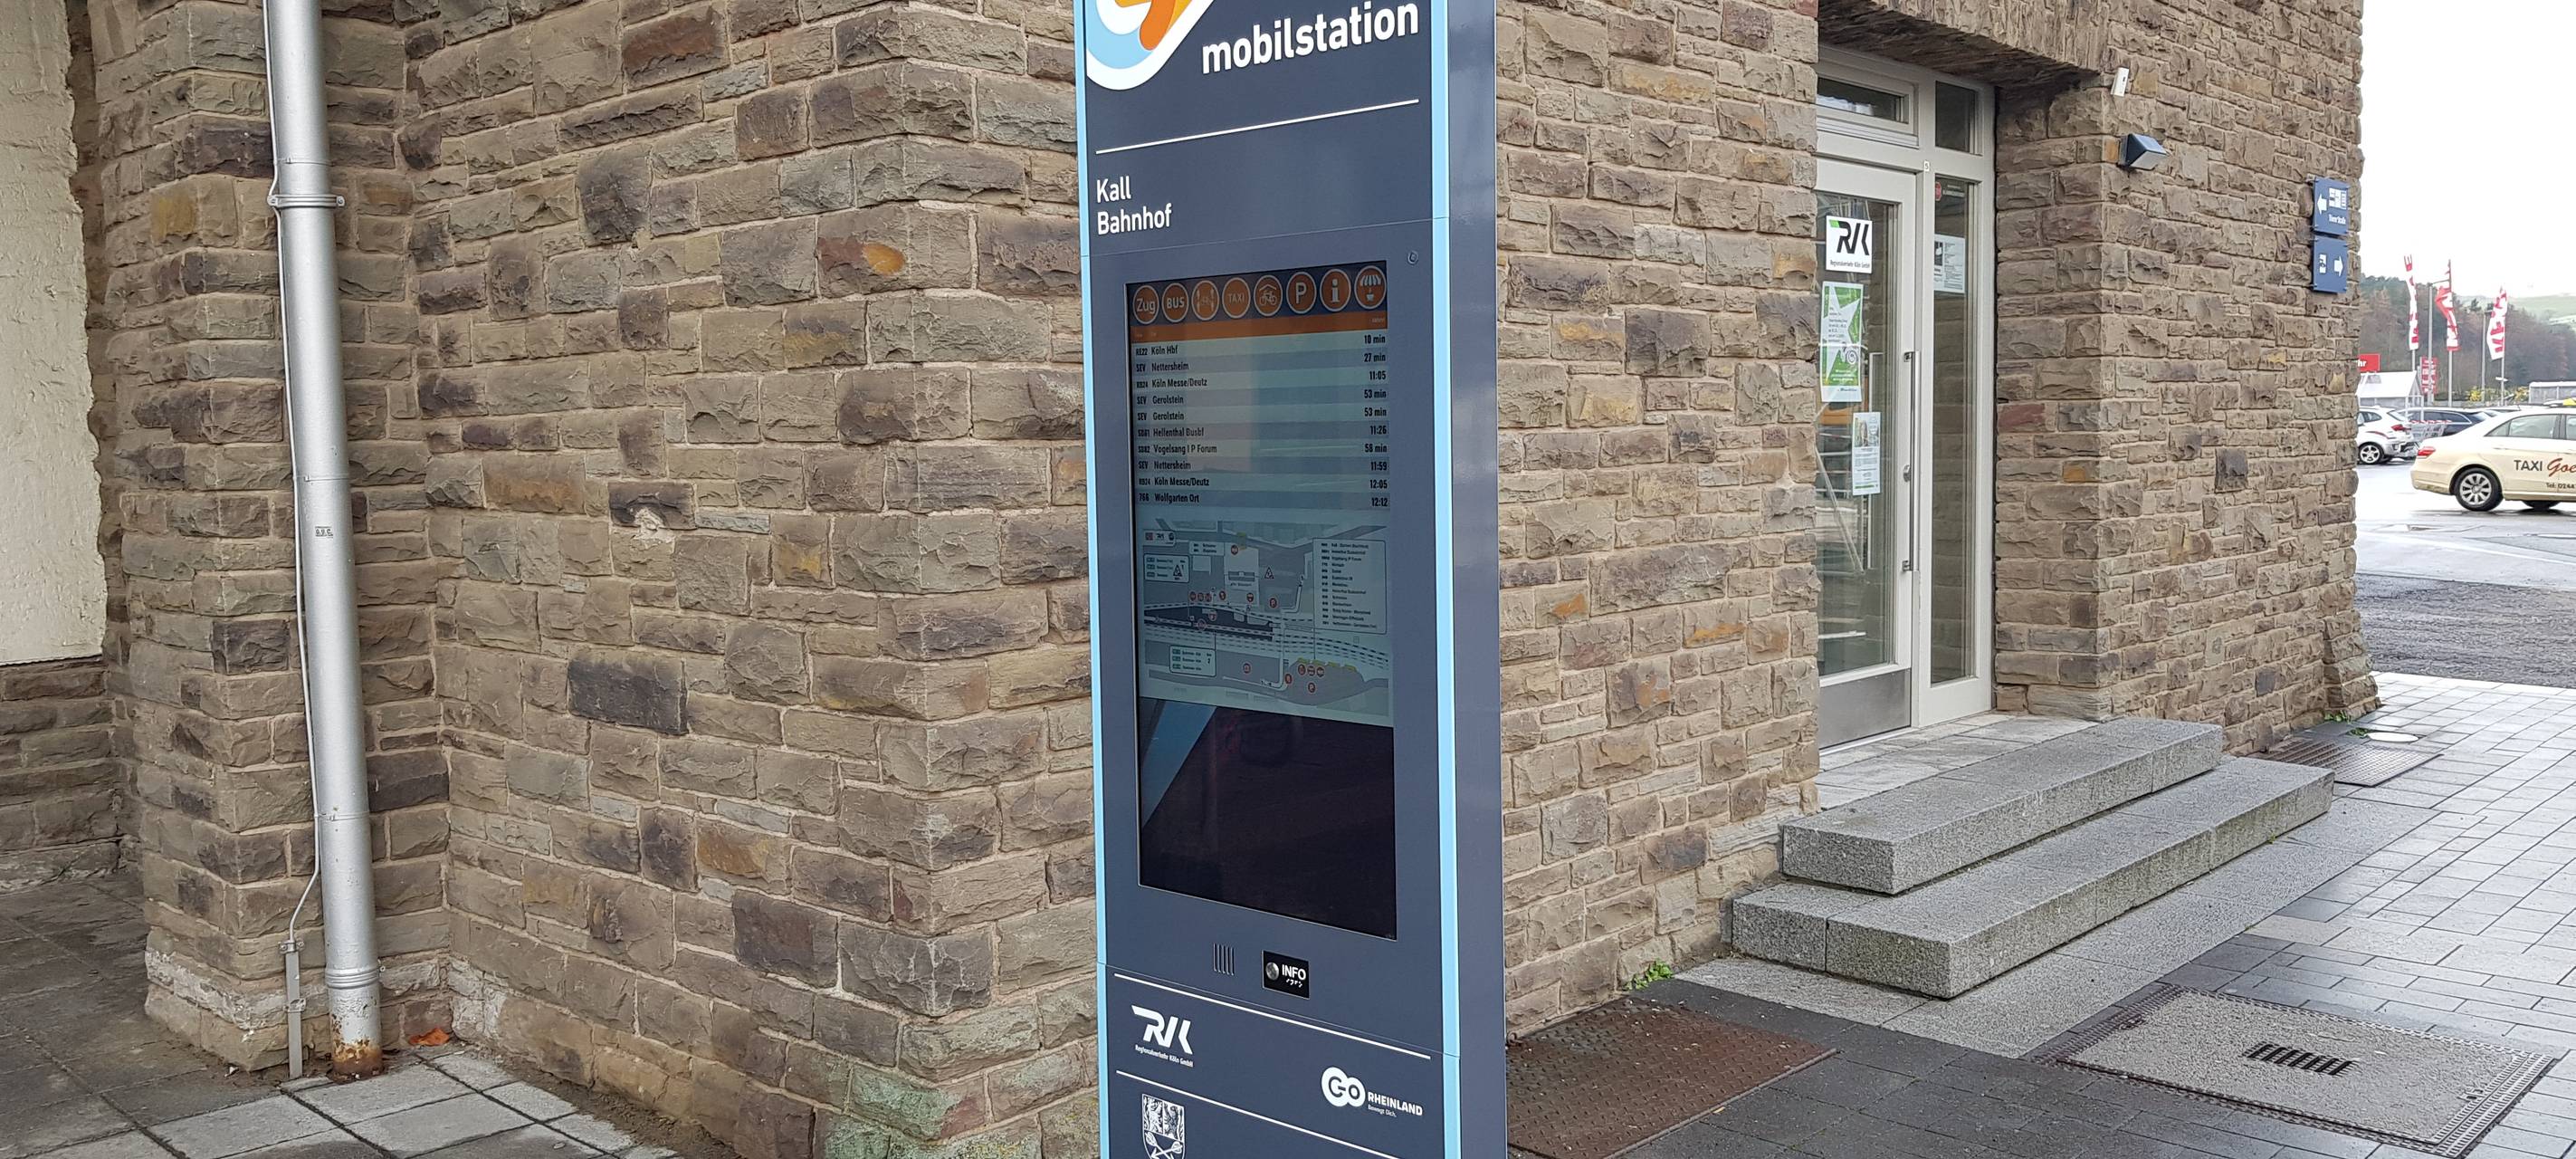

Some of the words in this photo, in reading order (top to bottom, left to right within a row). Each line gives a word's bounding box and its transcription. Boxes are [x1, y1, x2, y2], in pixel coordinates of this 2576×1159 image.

[1202, 1, 1418, 74] mobilstation
[1096, 176, 1131, 204] Kall
[1097, 203, 1172, 235] Bahnhof
[1137, 298, 1156, 314] Zug
[1167, 297, 1185, 309] BUS
[1228, 292, 1245, 302] TAXI
[1296, 282, 1307, 304] P
[1151, 346, 1166, 356] Köln
[1167, 345, 1178, 355] Hbf
[1364, 334, 1371, 344] 10
[1373, 334, 1386, 343] min
[1151, 362, 1188, 372] Nettersheim
[1364, 353, 1372, 362] 27
[1373, 352, 1386, 362] min
[2357, 359, 2367, 368] hr
[1151, 378, 1166, 388] Köln
[1168, 378, 1207, 388] Messe/Deutz
[1369, 370, 1387, 380] 11:05
[1137, 397, 1147, 405] SEV
[1152, 395, 1184, 405] Gerolstein
[1364, 388, 1372, 398] 53
[1374, 388, 1387, 398] min
[1138, 412, 1147, 420] SEV
[1153, 411, 1184, 420] Gerolstein
[1364, 407, 1373, 417] 53
[1374, 407, 1387, 417] min
[1153, 427, 1185, 437] Hellenthal
[1369, 425, 1387, 435] 11:26
[1153, 444, 1186, 455] Vogelsang
[1197, 444, 1217, 453] Forum
[1364, 443, 1373, 453] 58
[1374, 443, 1388, 453] min
[1139, 461, 1148, 469] SEV
[1154, 460, 1191, 470] Nettersheim
[1370, 461, 1388, 471] 11:59
[2514, 460, 2543, 471] TAXI
[1154, 477, 1169, 486] Köln
[1169, 477, 1209, 486] Messe/Deutz
[1369, 479, 1388, 489] 12:05
[1154, 493, 1188, 503] Wolfgarten
[1189, 494, 1199, 503] Ort
[1371, 497, 1388, 507] 12:12
[1282, 964, 1306, 981] INFO
[1368, 1092, 1423, 1116] RHEINLAND
